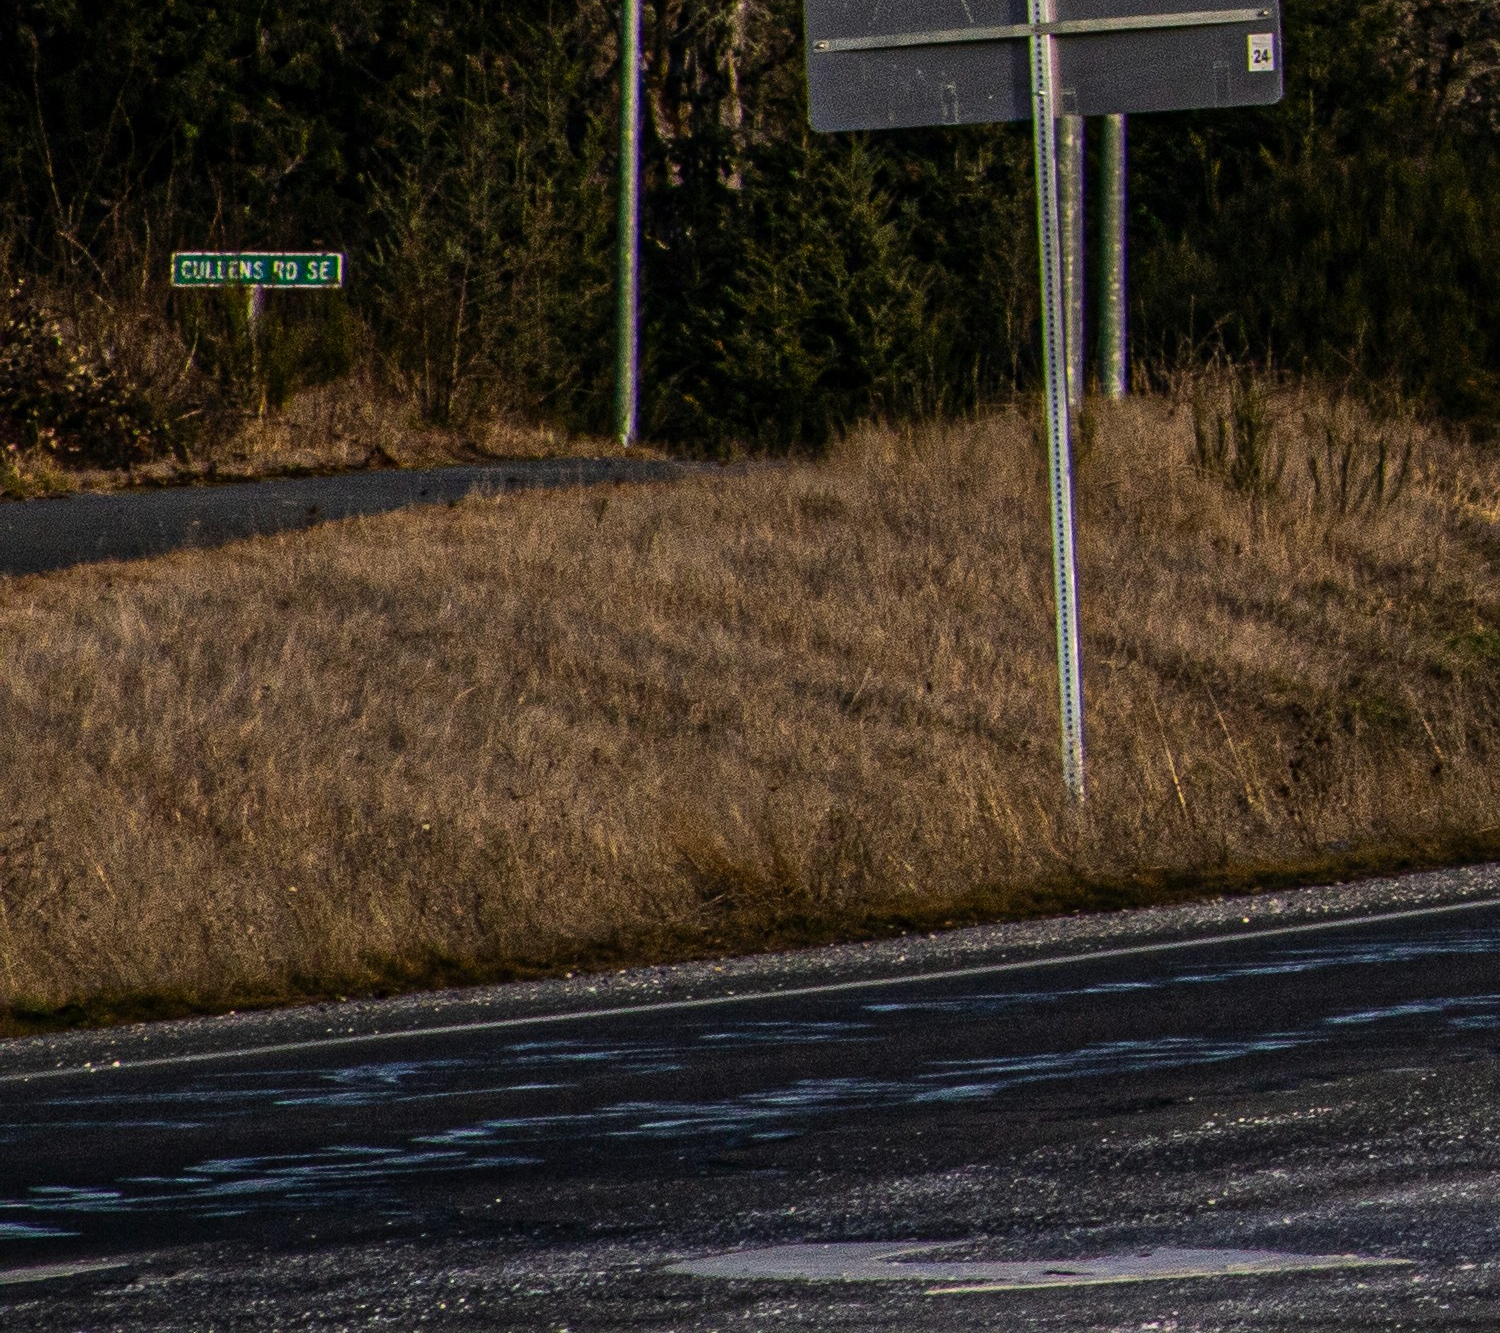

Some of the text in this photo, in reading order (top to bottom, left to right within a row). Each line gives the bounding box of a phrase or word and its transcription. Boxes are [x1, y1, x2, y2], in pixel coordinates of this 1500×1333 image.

[1253, 48, 1270, 63] 24
[181, 260, 330, 281] CULLENS RD SE
